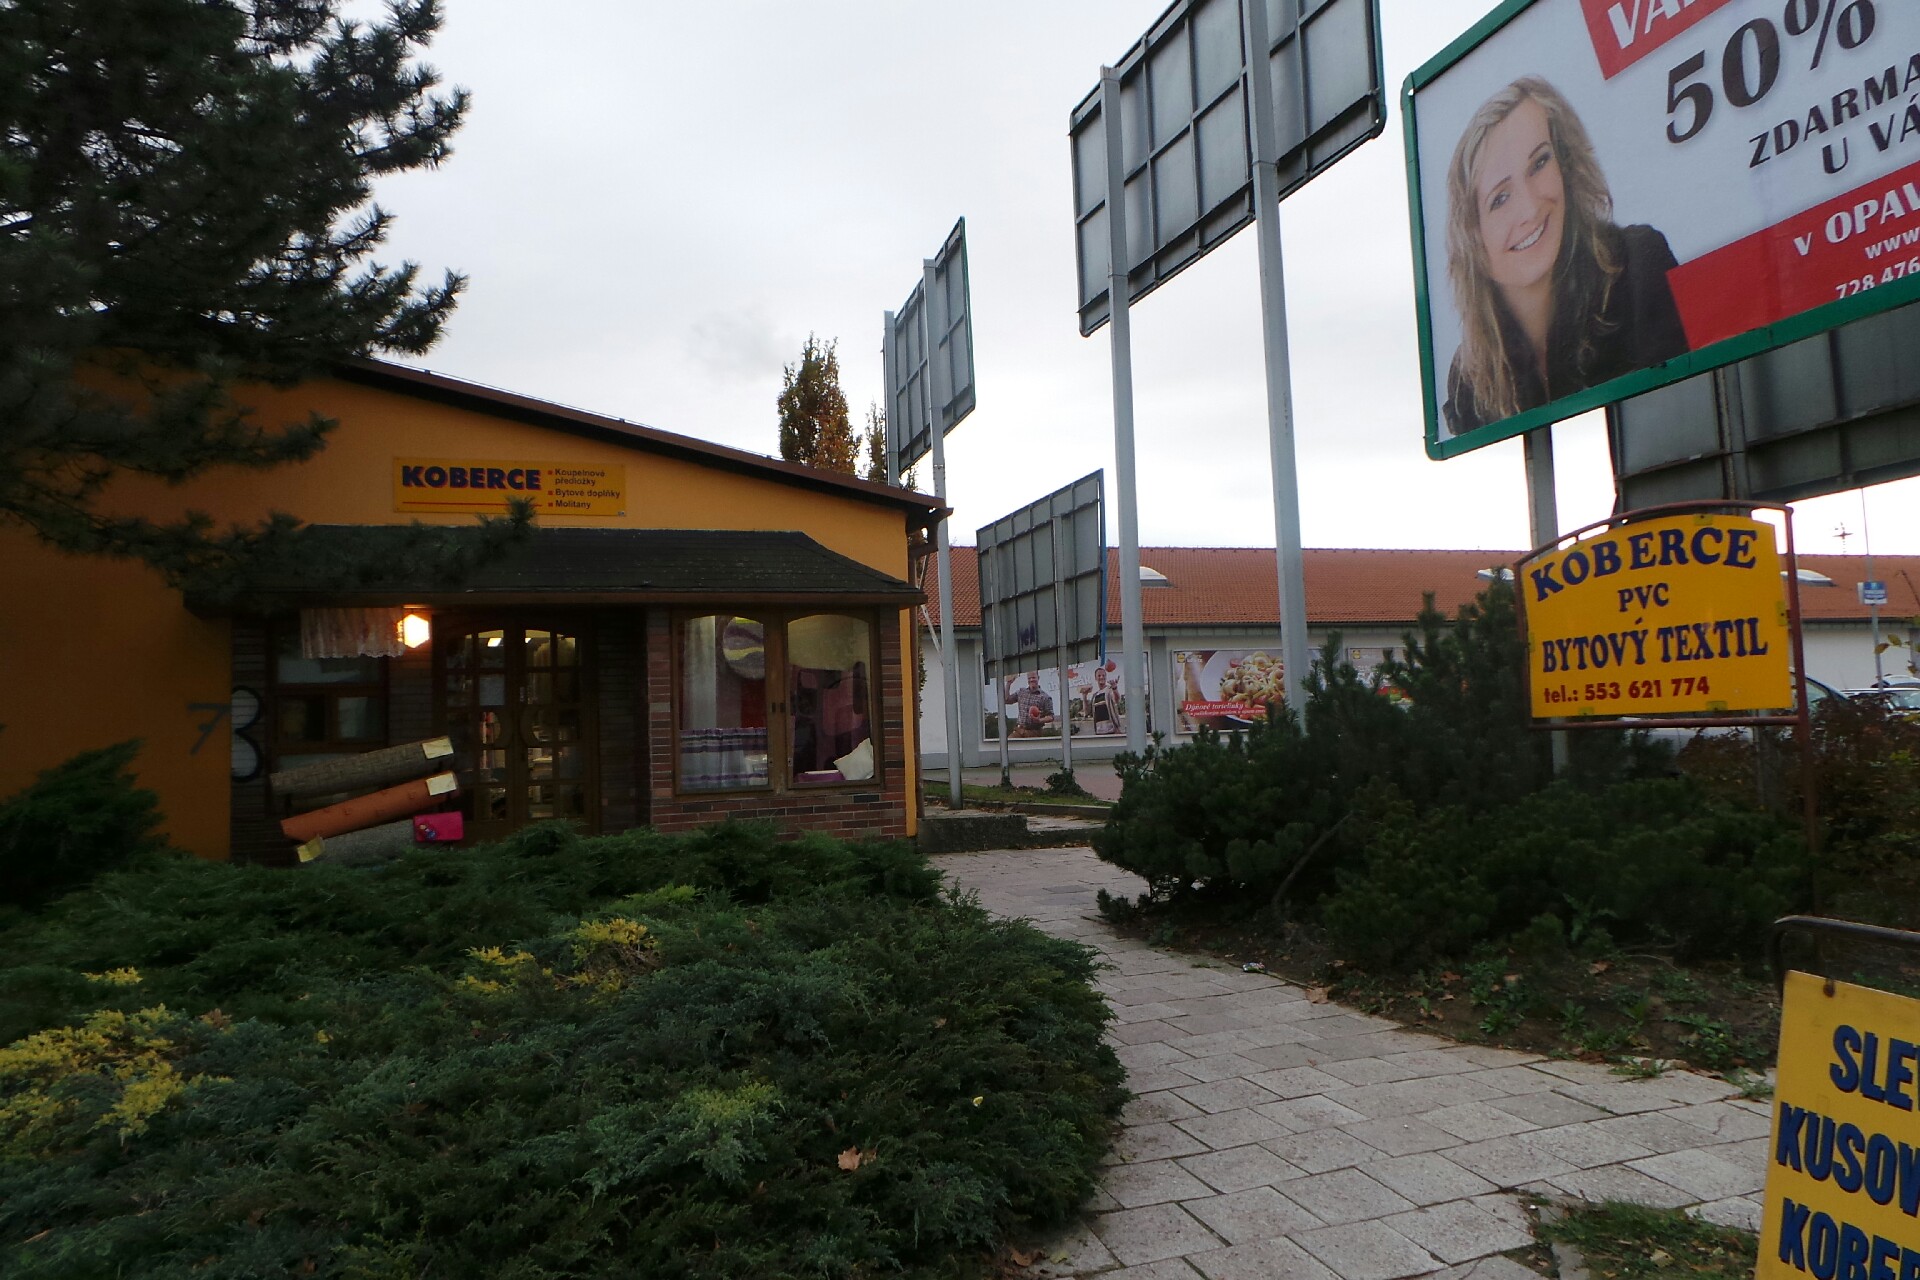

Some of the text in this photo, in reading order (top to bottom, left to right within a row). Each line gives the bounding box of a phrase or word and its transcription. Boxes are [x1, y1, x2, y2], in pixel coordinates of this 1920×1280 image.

[1608, 0, 1696, 49] VA
[1666, 0, 1875, 144] 50%
[1821, 138, 1849, 174] U
[1835, 256, 1920, 299] 728 476
[402, 465, 542, 490] KOBERCE
[555, 477, 596, 487] předložky
[555, 488, 621, 499] Bytové doplňky
[555, 499, 591, 509] Molitany
[1530, 527, 1758, 602] KOBERCE
[1617, 582, 1669, 612] PVC
[1542, 617, 1768, 673] BYTOVÝ TEXTIL
[1544, 676, 1710, 703] tel.: 553 621 774
[1829, 1024, 1920, 1113] SLE
